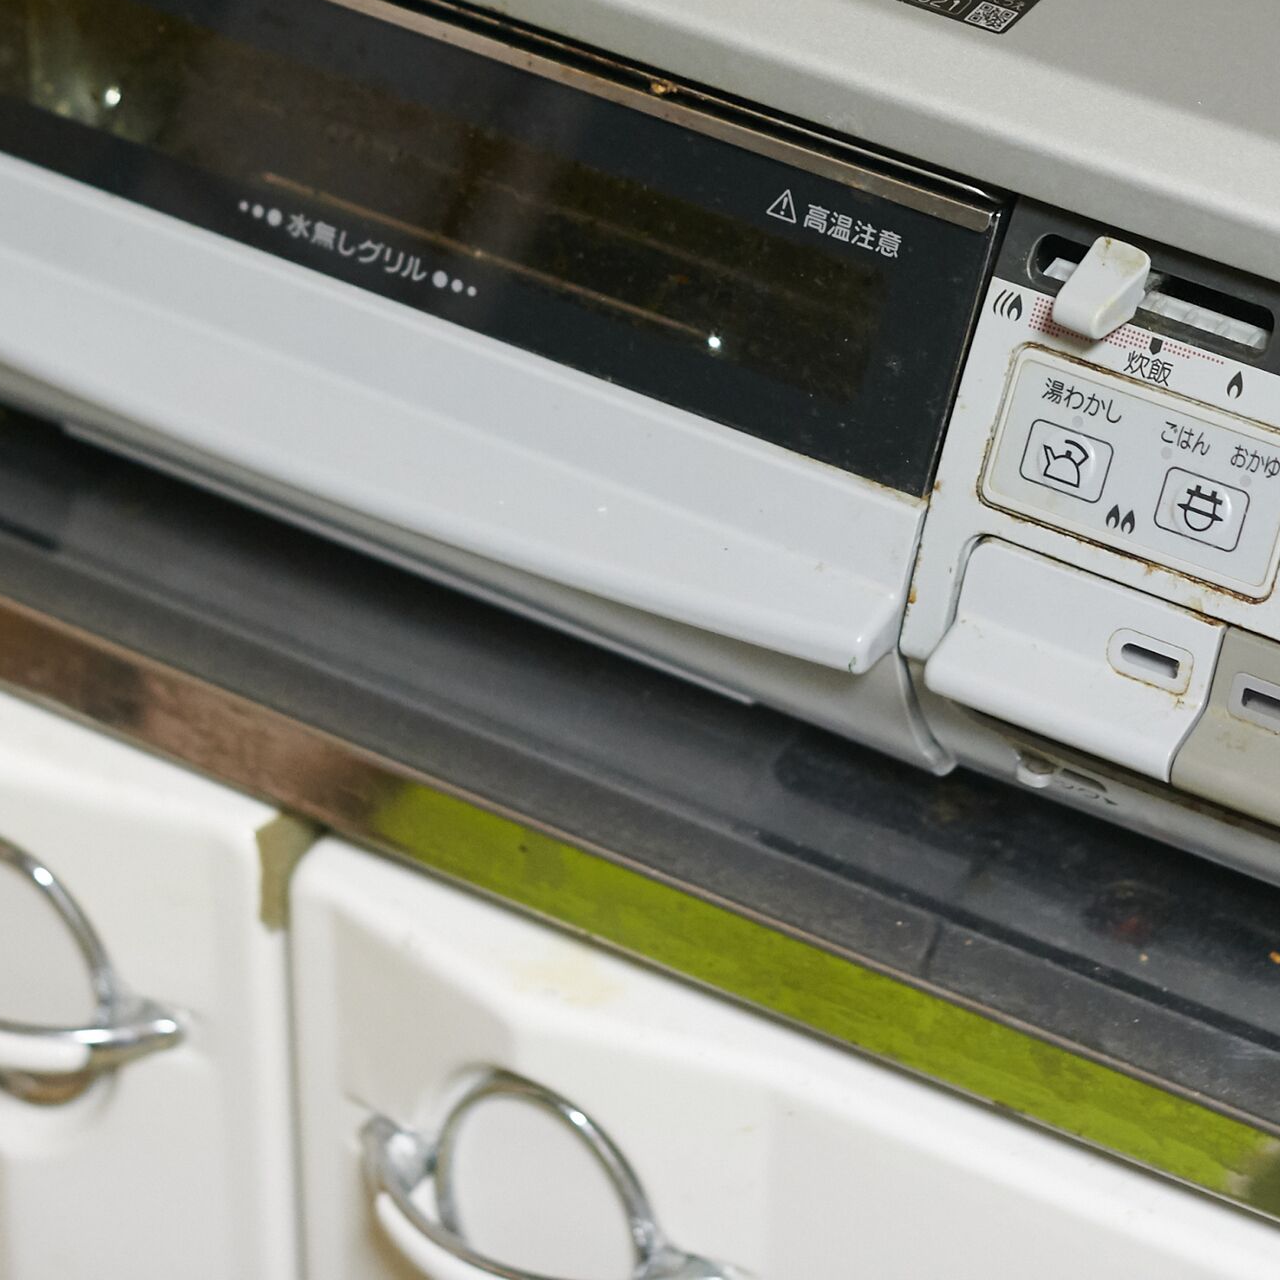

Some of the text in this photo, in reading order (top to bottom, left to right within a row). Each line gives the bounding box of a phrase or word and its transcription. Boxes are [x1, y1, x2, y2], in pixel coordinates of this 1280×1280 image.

[285, 212, 428, 282] 水無しグリル
[802, 203, 903, 259] 高温注意
[1122, 349, 1175, 387] 炊飯
[1041, 376, 1123, 424] 湯わかし
[1160, 420, 1212, 456] ごはん
[1229, 444, 1280, 479] おかゆ
